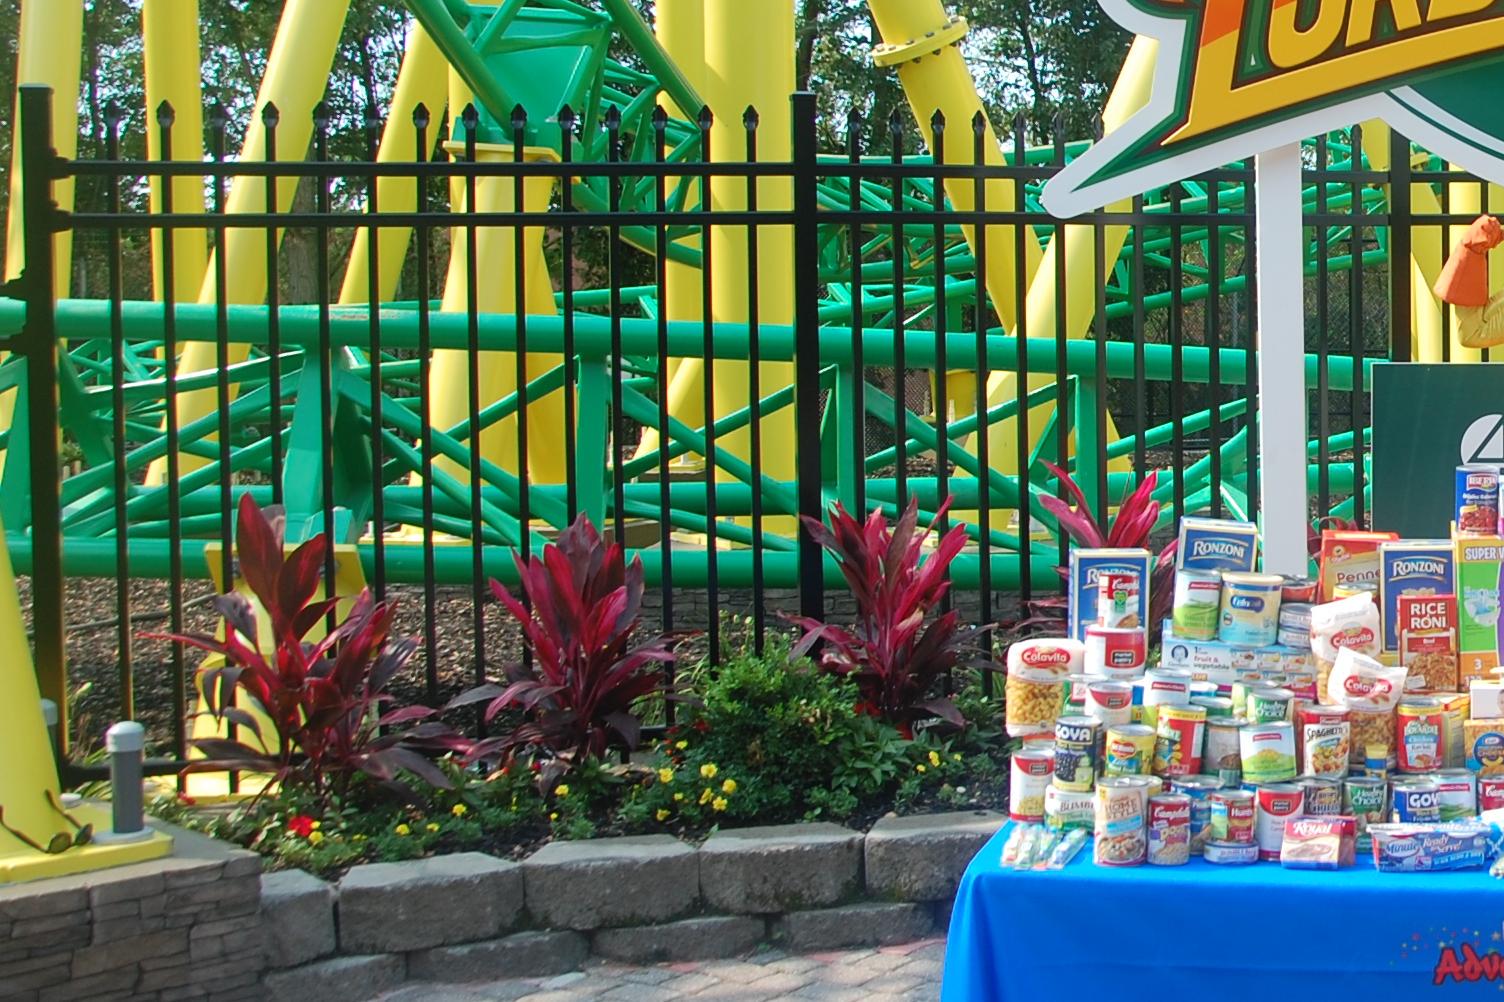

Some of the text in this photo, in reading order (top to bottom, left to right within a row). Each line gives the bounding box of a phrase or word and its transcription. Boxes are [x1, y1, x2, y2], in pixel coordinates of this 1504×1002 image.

[1193, 540, 1245, 558] RONZONI
[1465, 546, 1497, 560] SUPER
[1393, 560, 1445, 577] RONZONI
[1411, 602, 1445, 616] RICE
[1333, 632, 1373, 647] Colavita
[1023, 651, 1068, 663] Colavita
[1055, 724, 1091, 741] GOYA
[1410, 793, 1440, 807] GOY
[1293, 822, 1333, 836] Royal
